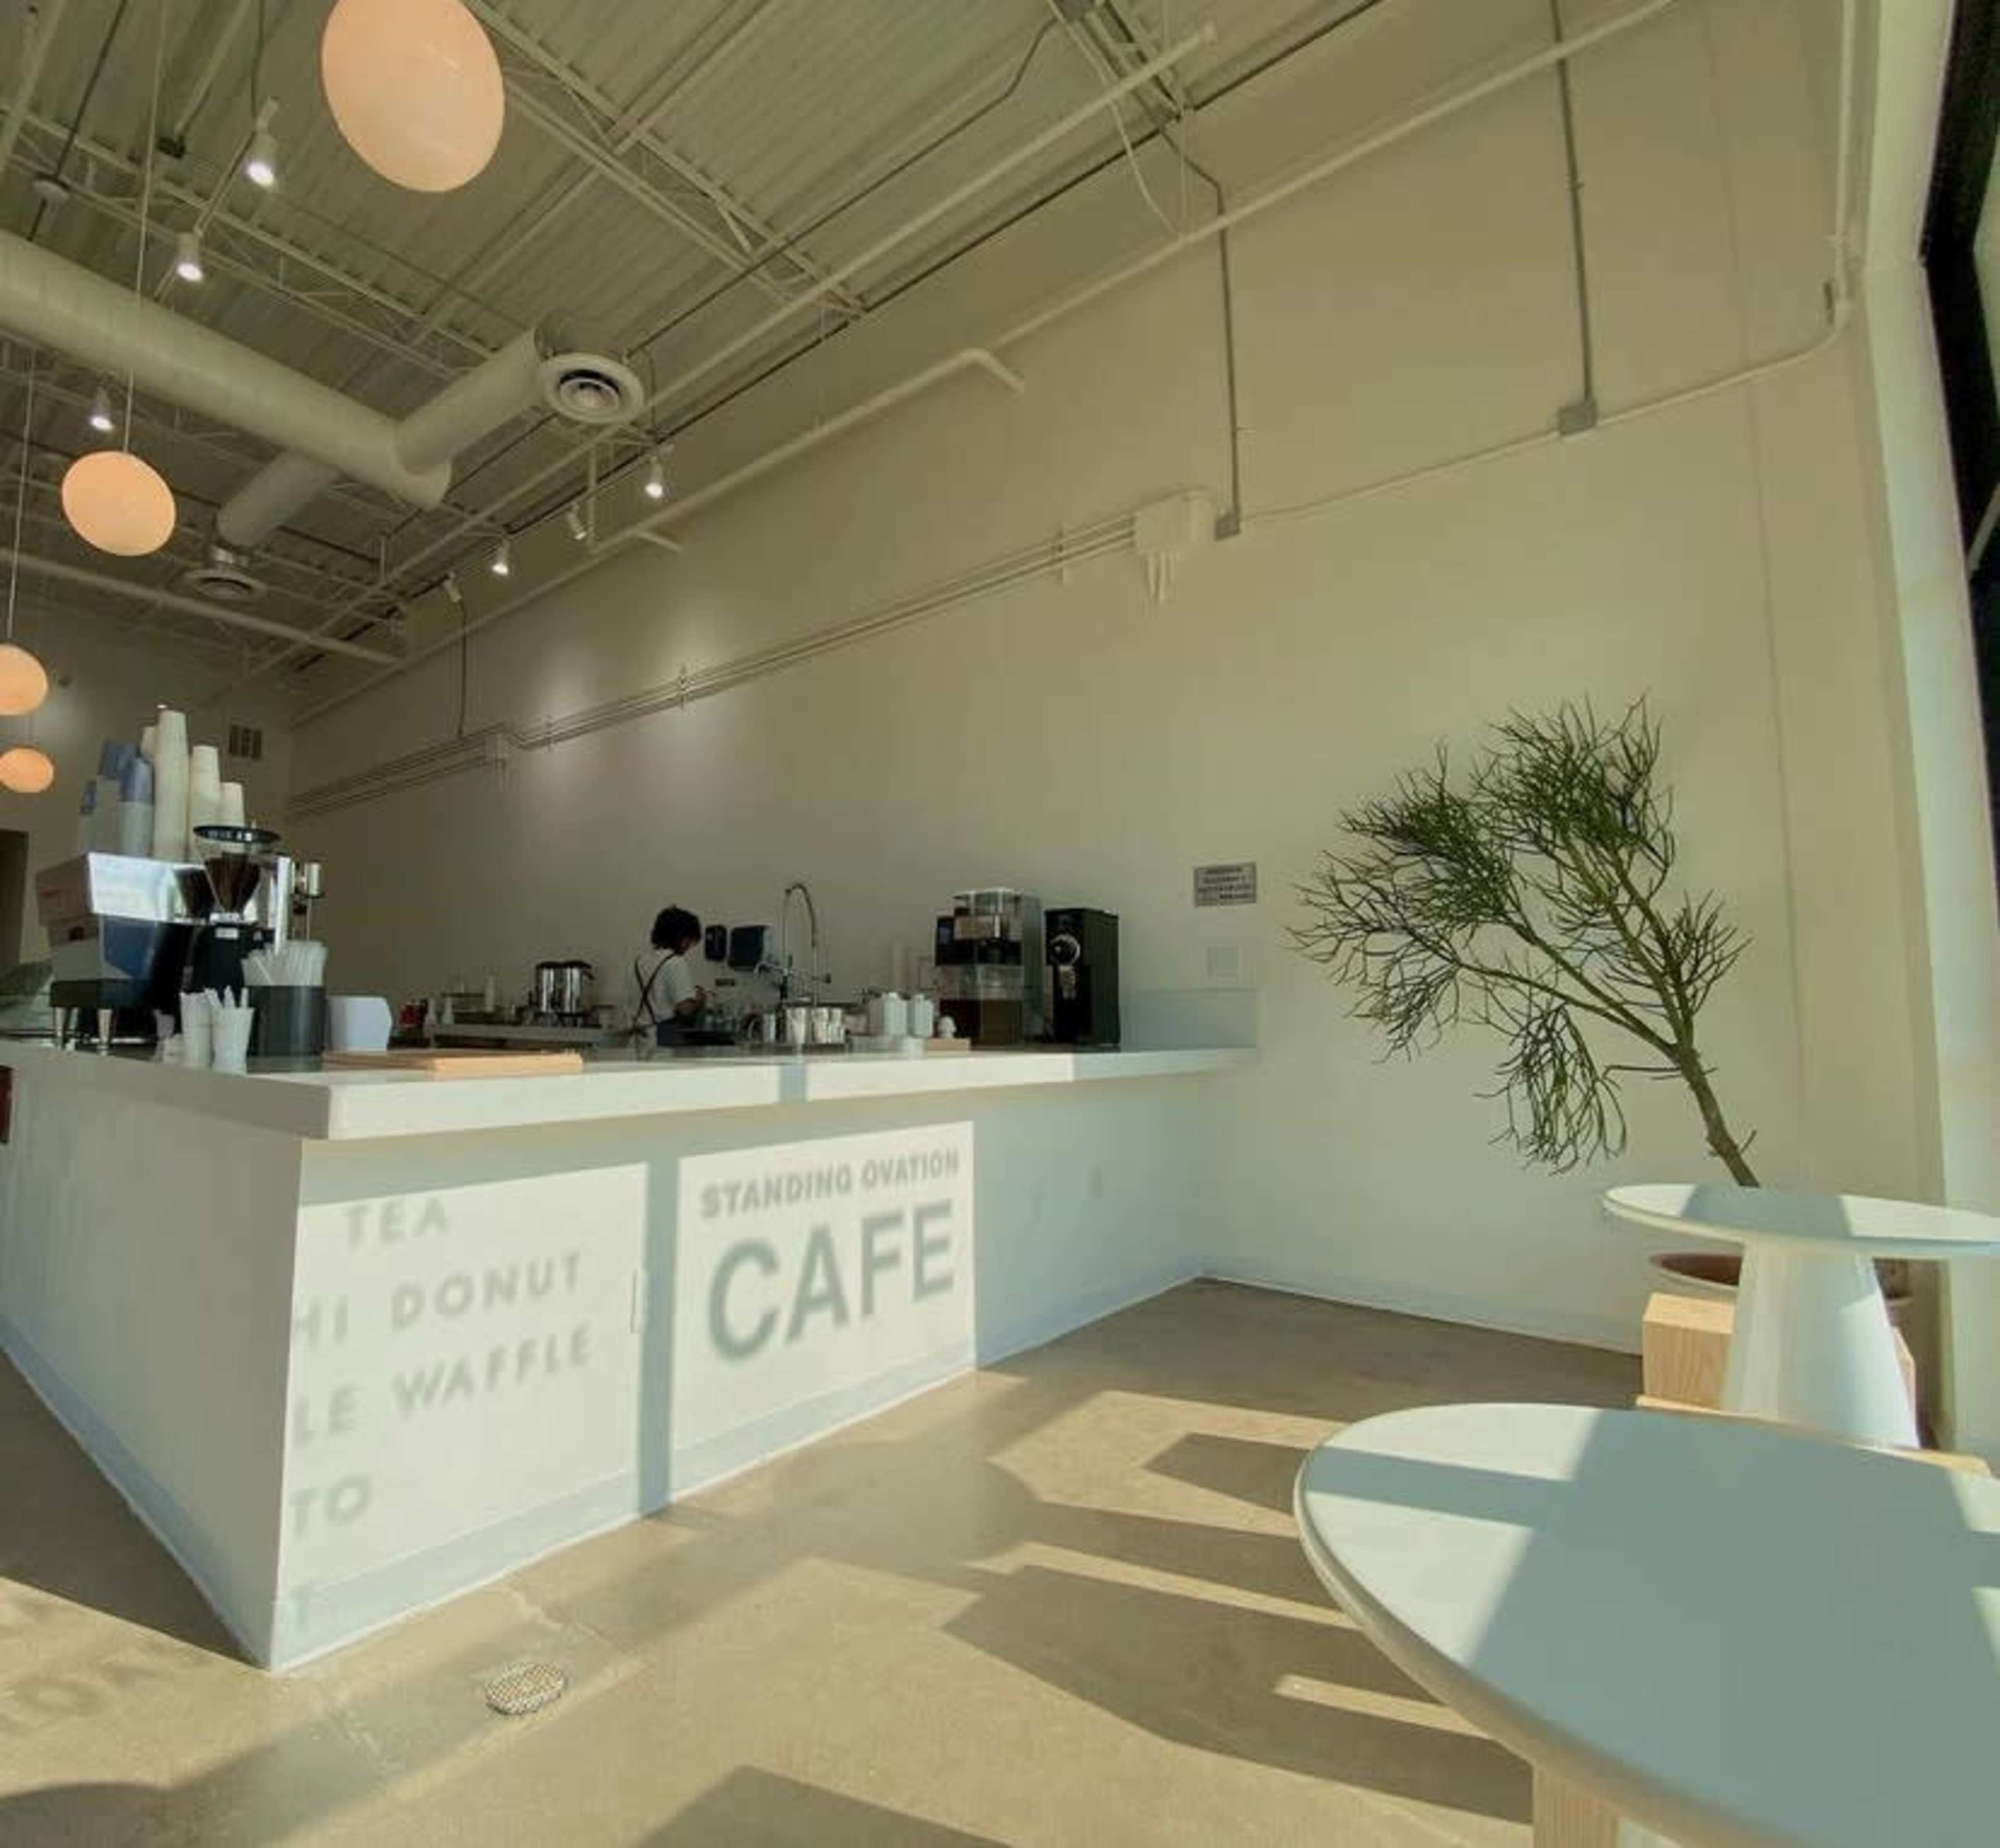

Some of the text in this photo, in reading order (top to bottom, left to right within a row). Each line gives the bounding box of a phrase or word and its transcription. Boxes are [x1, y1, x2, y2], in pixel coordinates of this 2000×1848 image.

[701, 1150, 960, 1218] STANDING OVATION
[344, 1197, 448, 1250] TEA
[391, 1252, 580, 1330] DONUT
[709, 1198, 954, 1363] CAFE
[392, 1322, 592, 1417] WAFFLE
